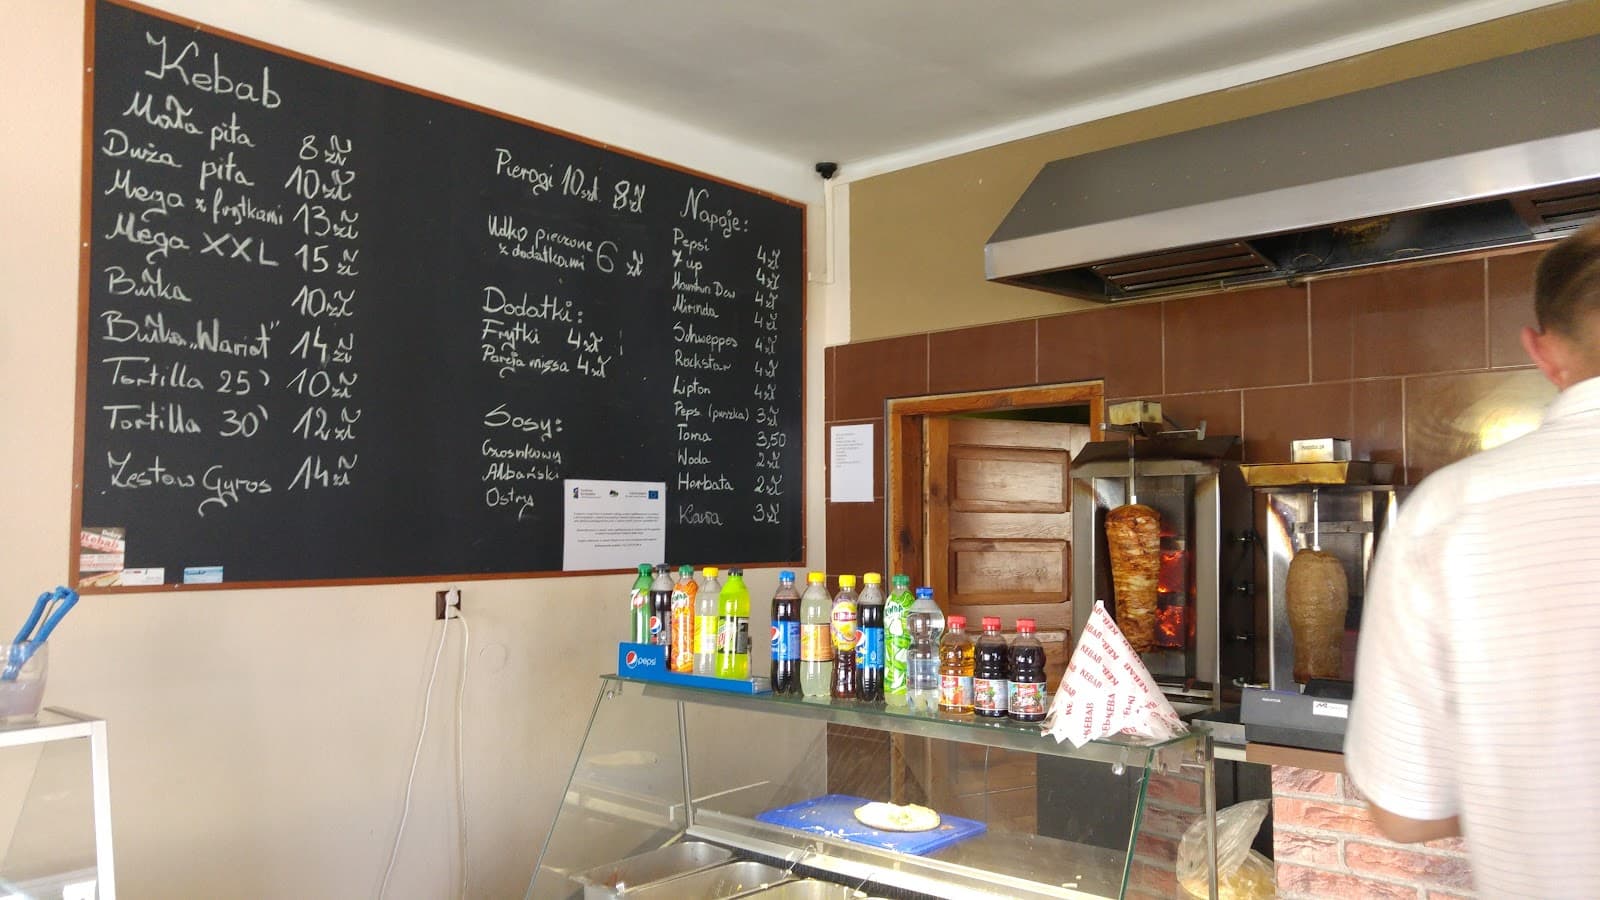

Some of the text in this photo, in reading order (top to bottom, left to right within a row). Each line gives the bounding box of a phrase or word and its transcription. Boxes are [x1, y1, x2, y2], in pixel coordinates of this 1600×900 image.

[145, 32, 281, 108] Kebab
[211, 112, 255, 150] pita
[201, 152, 254, 190] pita
[495, 148, 553, 196] Pierogi
[105, 169, 184, 222] Mega
[213, 188, 283, 224] frytkami
[680, 187, 749, 238] Napoje:
[105, 212, 190, 264] Mega
[200, 232, 279, 266] XXL
[488, 215, 593, 252] Udko pieczone
[673, 228, 710, 255] Pepsi
[512, 244, 585, 271] dodatkami
[597, 241, 618, 272] 6
[482, 286, 583, 324] Dodatki:
[713, 281, 736, 299] Dew
[481, 318, 540, 350] Frytki
[102, 357, 204, 390] Tortilla
[674, 349, 732, 371] Rockstar
[673, 375, 711, 398] Lipton
[102, 401, 201, 434] Tortilla
[483, 403, 563, 442] Sosy:
[677, 423, 786, 450] Toma 3,50
[678, 448, 712, 466] Woda
[198, 465, 272, 517] Gyros
[678, 472, 734, 491] Herbata
[486, 487, 534, 522] Ostry
